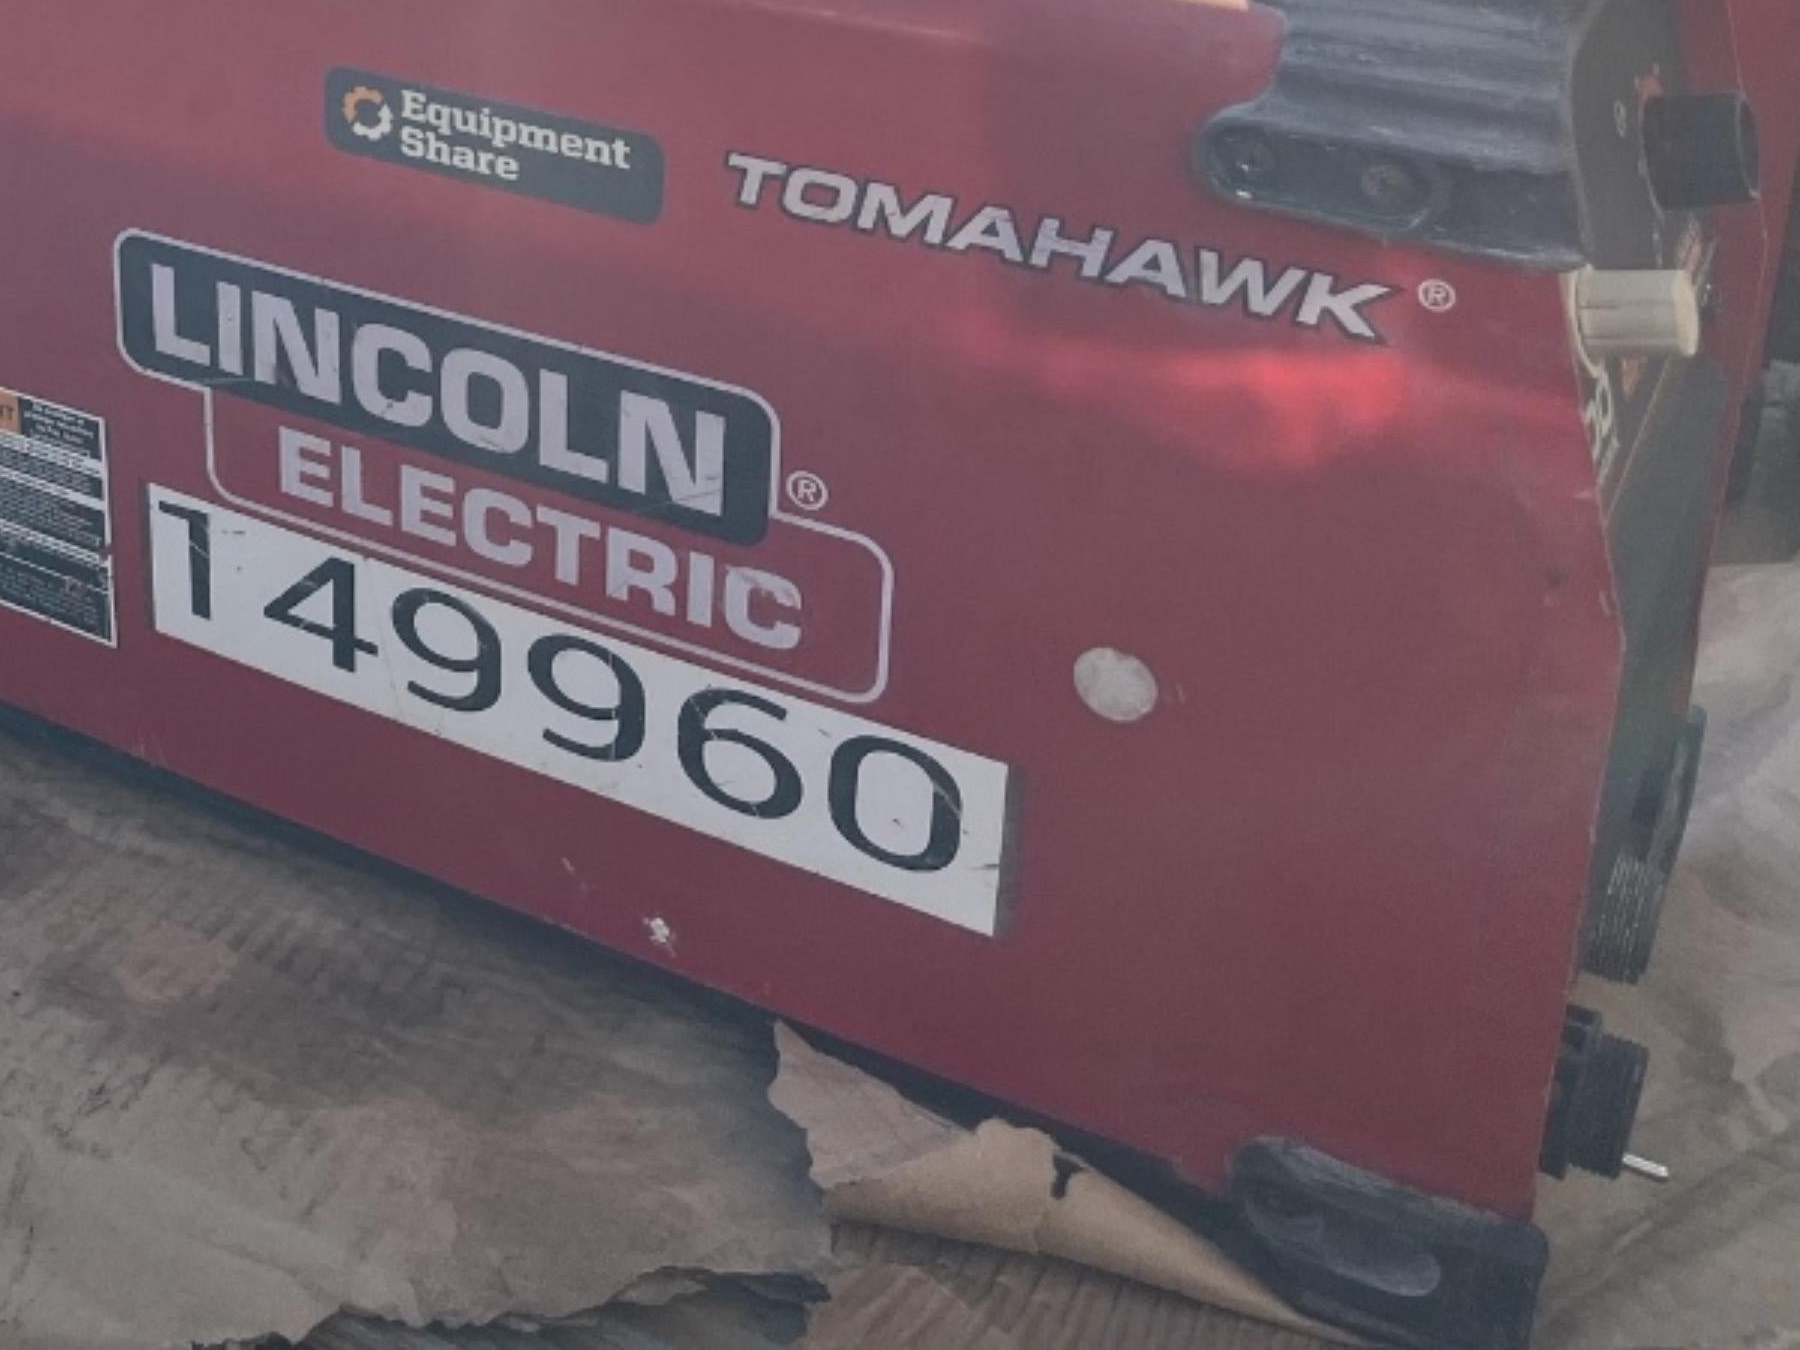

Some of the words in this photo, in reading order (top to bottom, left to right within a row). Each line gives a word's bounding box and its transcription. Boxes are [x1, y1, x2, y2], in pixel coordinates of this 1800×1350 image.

[400, 128, 519, 180] Share
[401, 89, 631, 169] Equipment
[725, 151, 1396, 341] TOMAHAWK
[151, 263, 726, 515] LINCOLN
[277, 425, 802, 650] ELECTRIC
[158, 499, 963, 873] 149960
